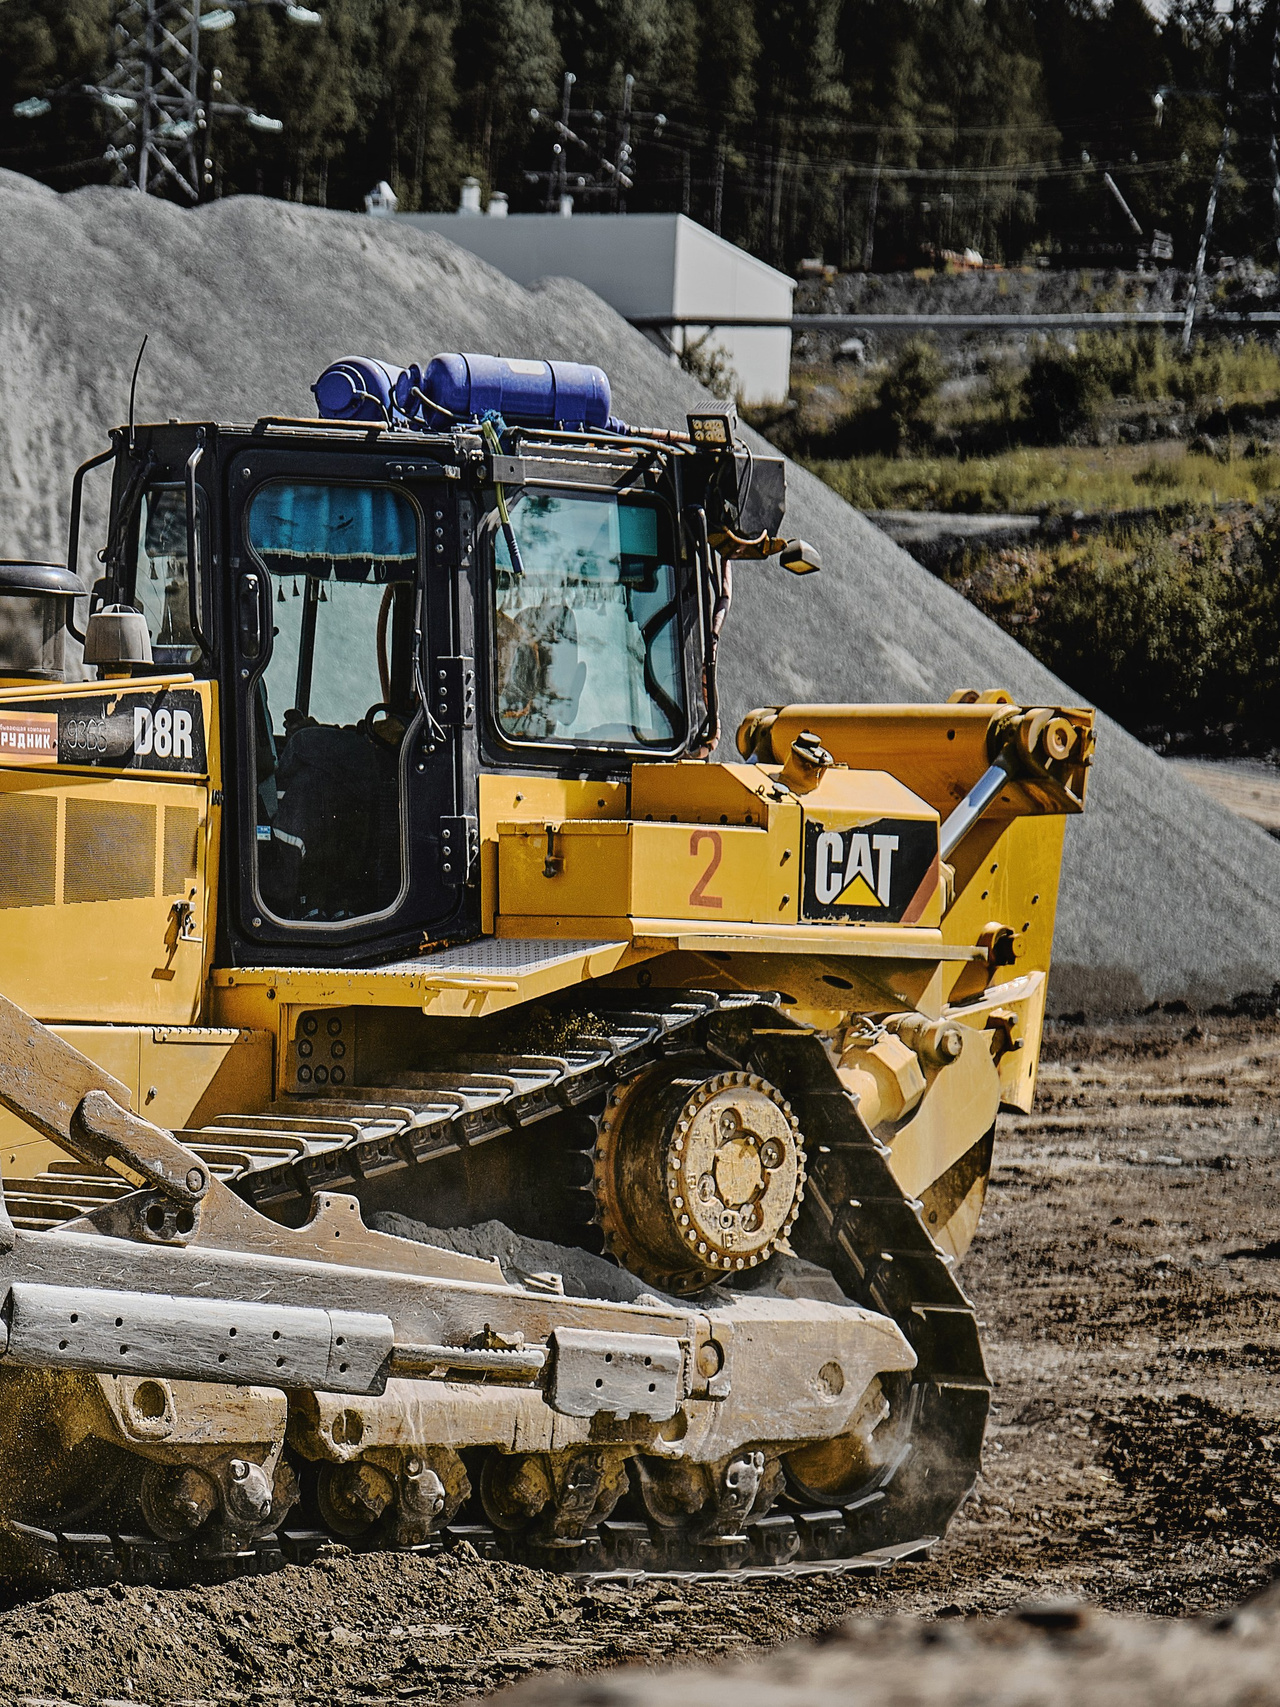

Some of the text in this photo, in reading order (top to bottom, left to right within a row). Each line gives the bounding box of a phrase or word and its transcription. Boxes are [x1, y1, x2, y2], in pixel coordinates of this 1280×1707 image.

[133, 706, 193, 759] D8R
[689, 829, 723, 908] 2
[815, 832, 899, 908] CAT
